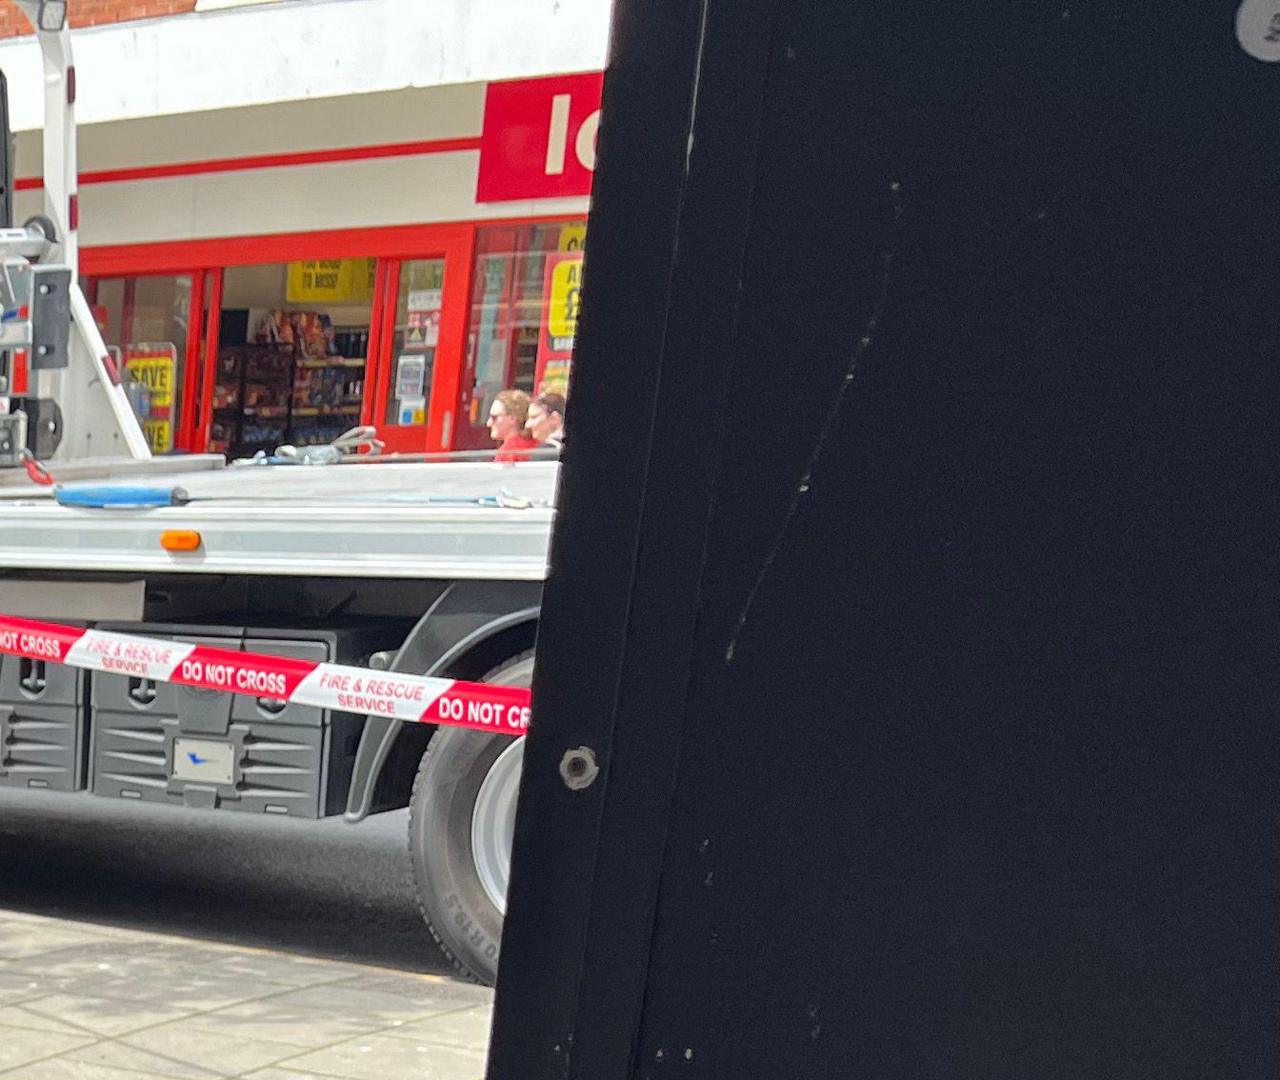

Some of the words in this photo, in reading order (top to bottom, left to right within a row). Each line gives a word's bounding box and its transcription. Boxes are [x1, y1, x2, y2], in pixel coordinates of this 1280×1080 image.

[130, 366, 168, 389] SAVE
[21, 635, 61, 657] CROSS
[125, 645, 170, 664] RESCUE
[101, 657, 148, 675] SERVICE
[182, 660, 203, 682] DO
[205, 664, 235, 688] NOT
[237, 667, 286, 695] CROSS
[319, 673, 351, 691] FIRE
[353, 676, 364, 692] &
[367, 679, 426, 700] RESCUE
[338, 695, 396, 715] SERVICE
[439, 698, 465, 720] DO
[467, 701, 506, 725] NOT
